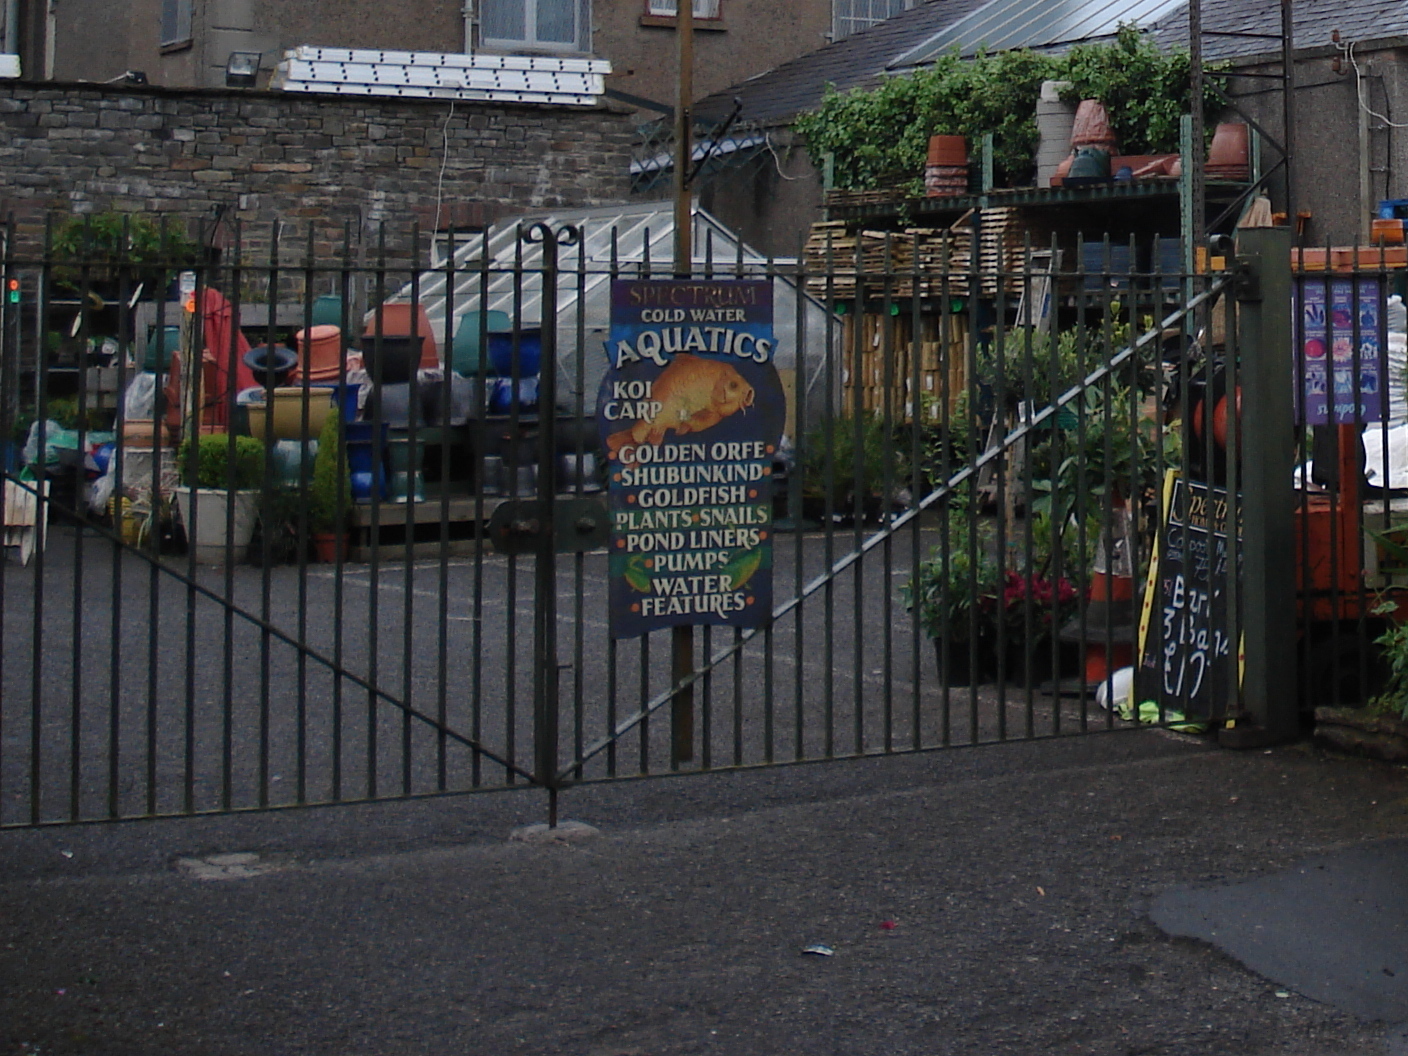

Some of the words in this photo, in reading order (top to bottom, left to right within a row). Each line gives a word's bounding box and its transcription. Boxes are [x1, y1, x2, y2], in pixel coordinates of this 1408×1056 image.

[630, 285, 757, 307] SPECTRUM
[641, 309, 686, 322] COLD
[690, 309, 746, 322] WATER
[616, 326, 772, 368] AQUATICS
[613, 381, 652, 399] KOI
[604, 401, 662, 424] CARP
[619, 444, 705, 464] GOLDEN
[711, 442, 764, 460] ORFE
[621, 463, 763, 486] SHUBUNKIND
[638, 486, 745, 507] GOLDFISH
[616, 510, 692, 530] PLANTS
[700, 506, 768, 526] SNAILS
[627, 532, 684, 552] POND
[690, 528, 760, 550] LINERS
[654, 551, 729, 572] PUMPS
[652, 575, 733, 596] WATER
[642, 593, 745, 619] FEATURES
